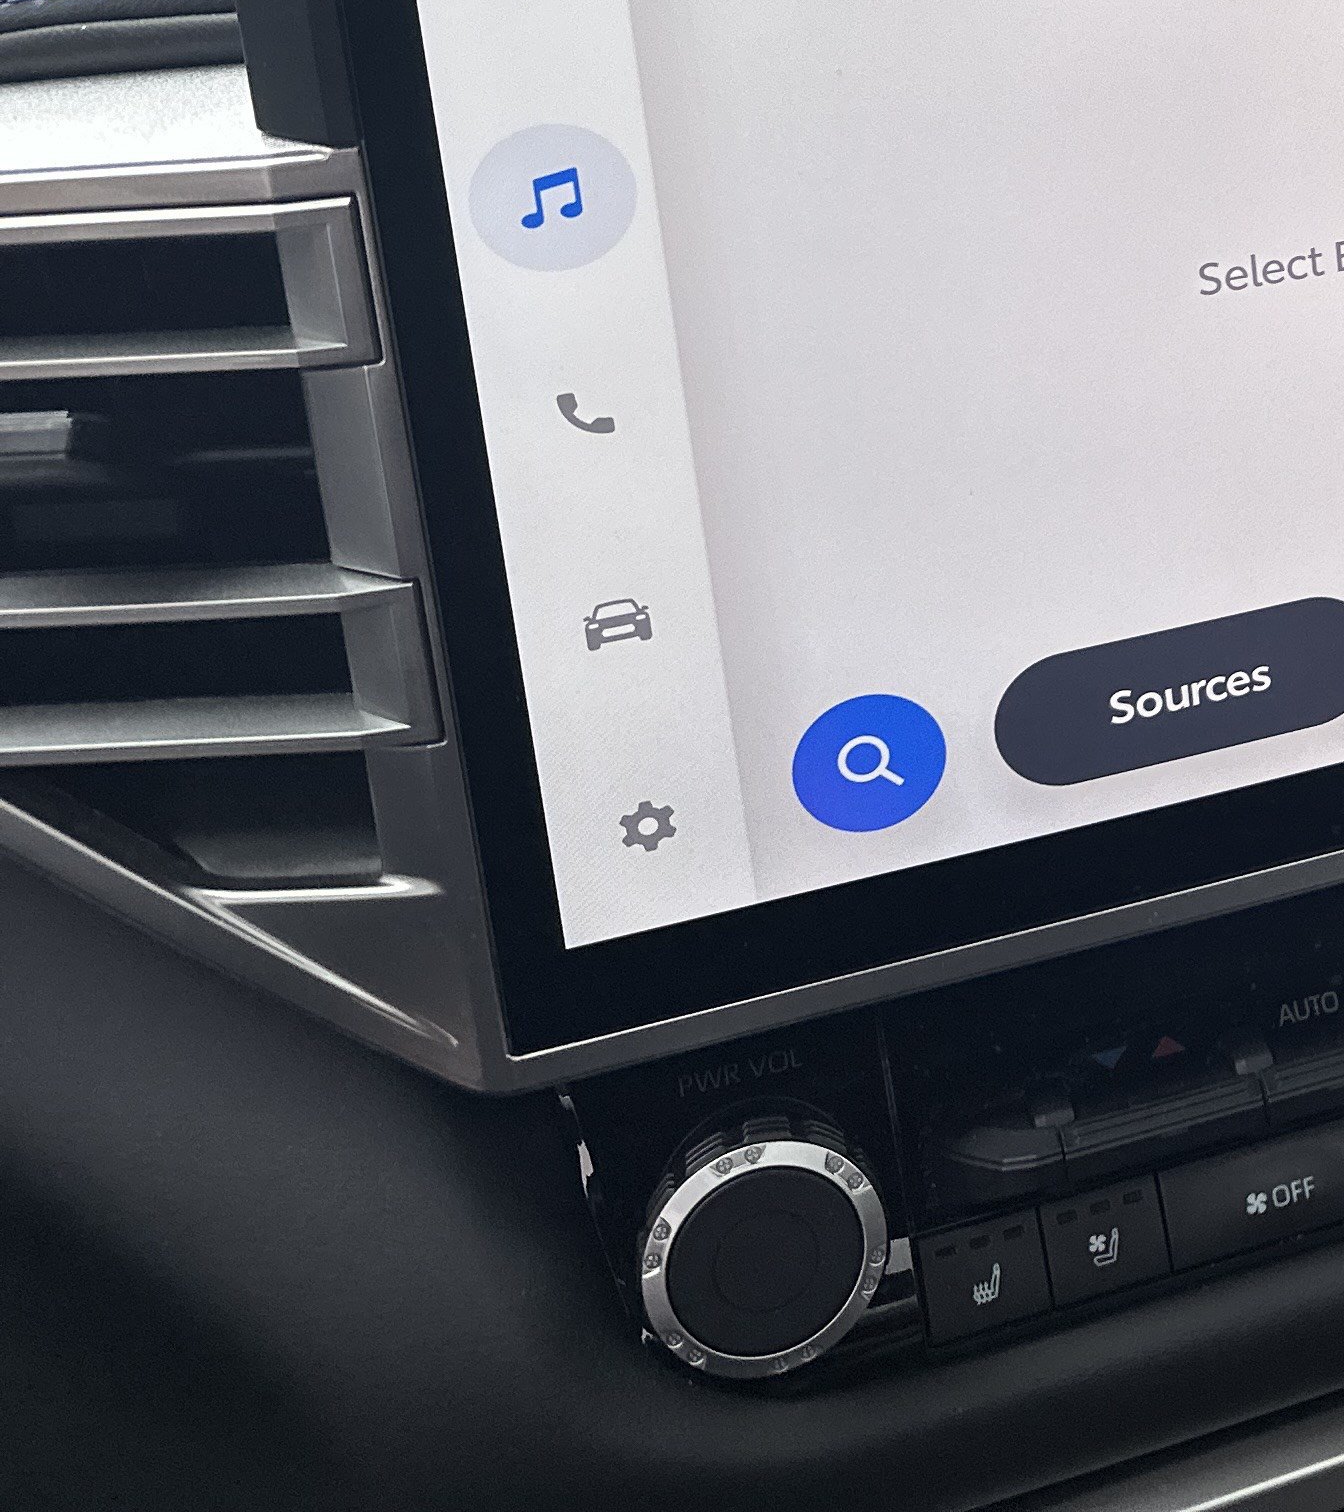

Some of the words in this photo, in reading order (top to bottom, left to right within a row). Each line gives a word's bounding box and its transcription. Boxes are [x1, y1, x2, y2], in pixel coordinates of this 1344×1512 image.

[1197, 245, 1326, 297] Select
[1108, 663, 1273, 726] Sources
[1278, 989, 1341, 1027] AUTO
[678, 1062, 742, 1098] PWR
[747, 1048, 804, 1079] VOL
[1271, 1175, 1317, 1210] OFF
